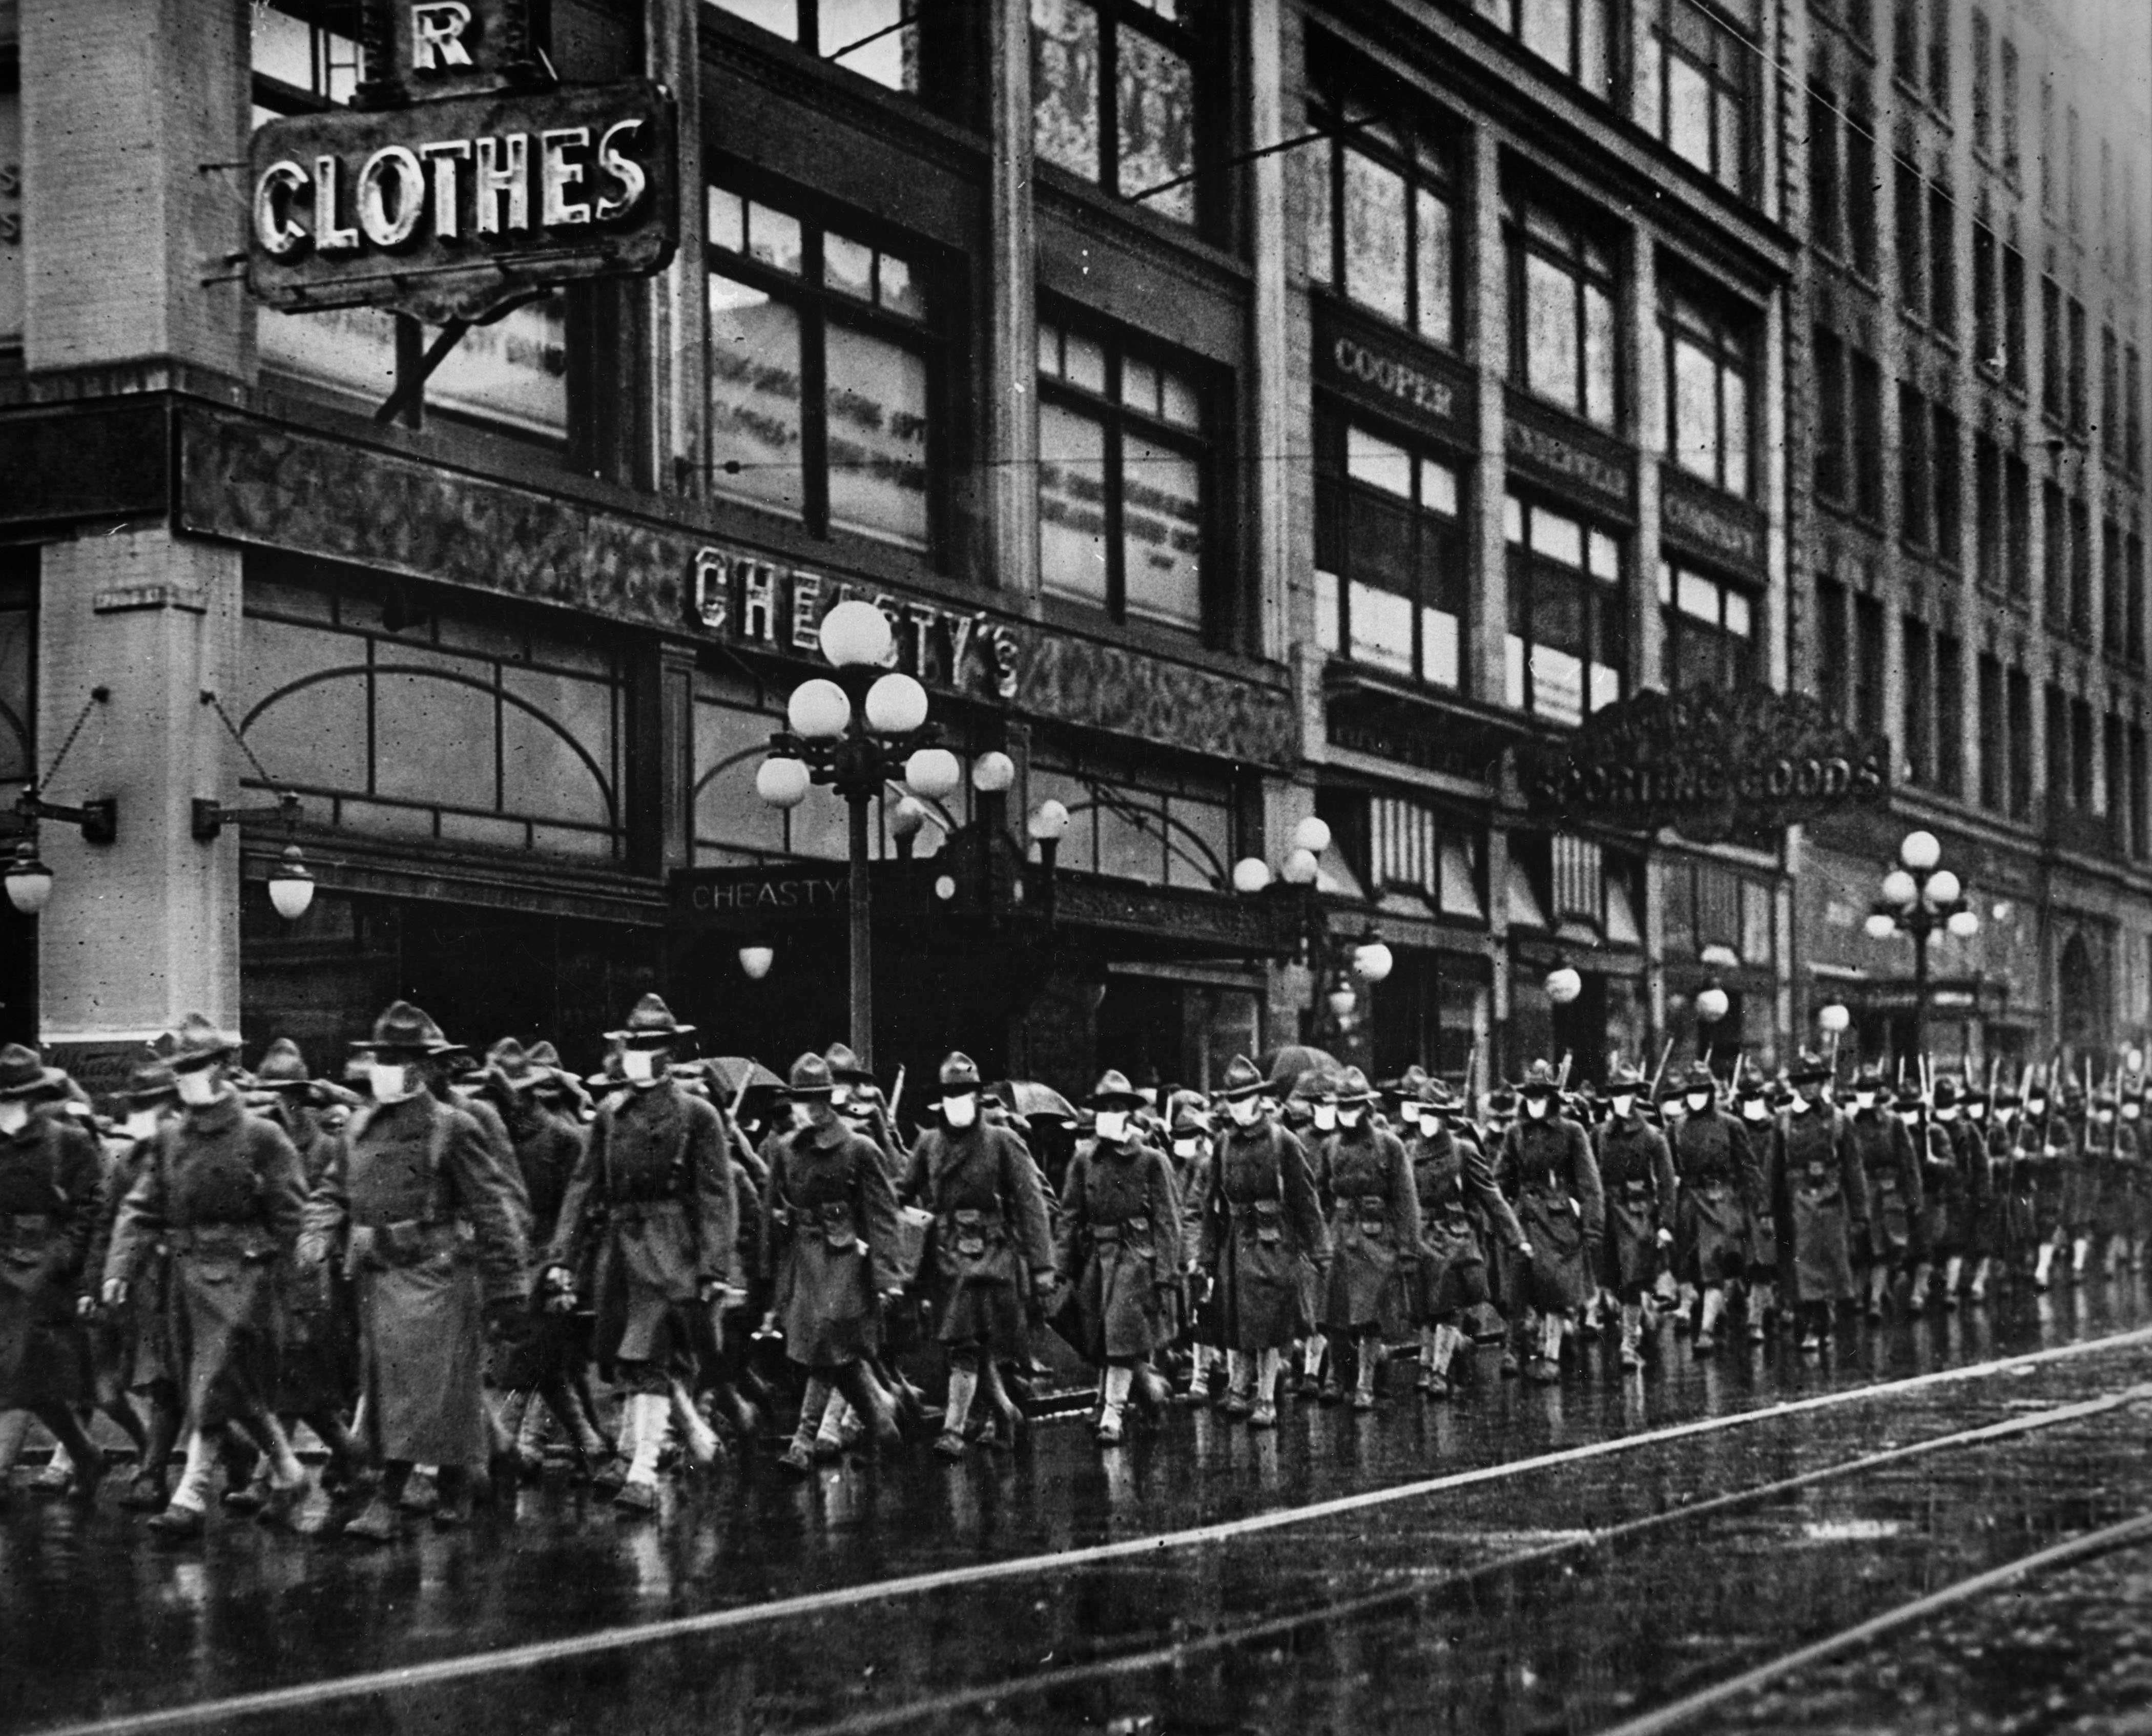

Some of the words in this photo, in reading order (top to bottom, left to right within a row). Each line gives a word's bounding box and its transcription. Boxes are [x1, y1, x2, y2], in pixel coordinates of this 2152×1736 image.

[412, 1, 473, 69] R
[253, 118, 646, 255] CLOTHES
[1334, 337, 1454, 418] COOPER
[694, 546, 1018, 698] CHESTY'S
